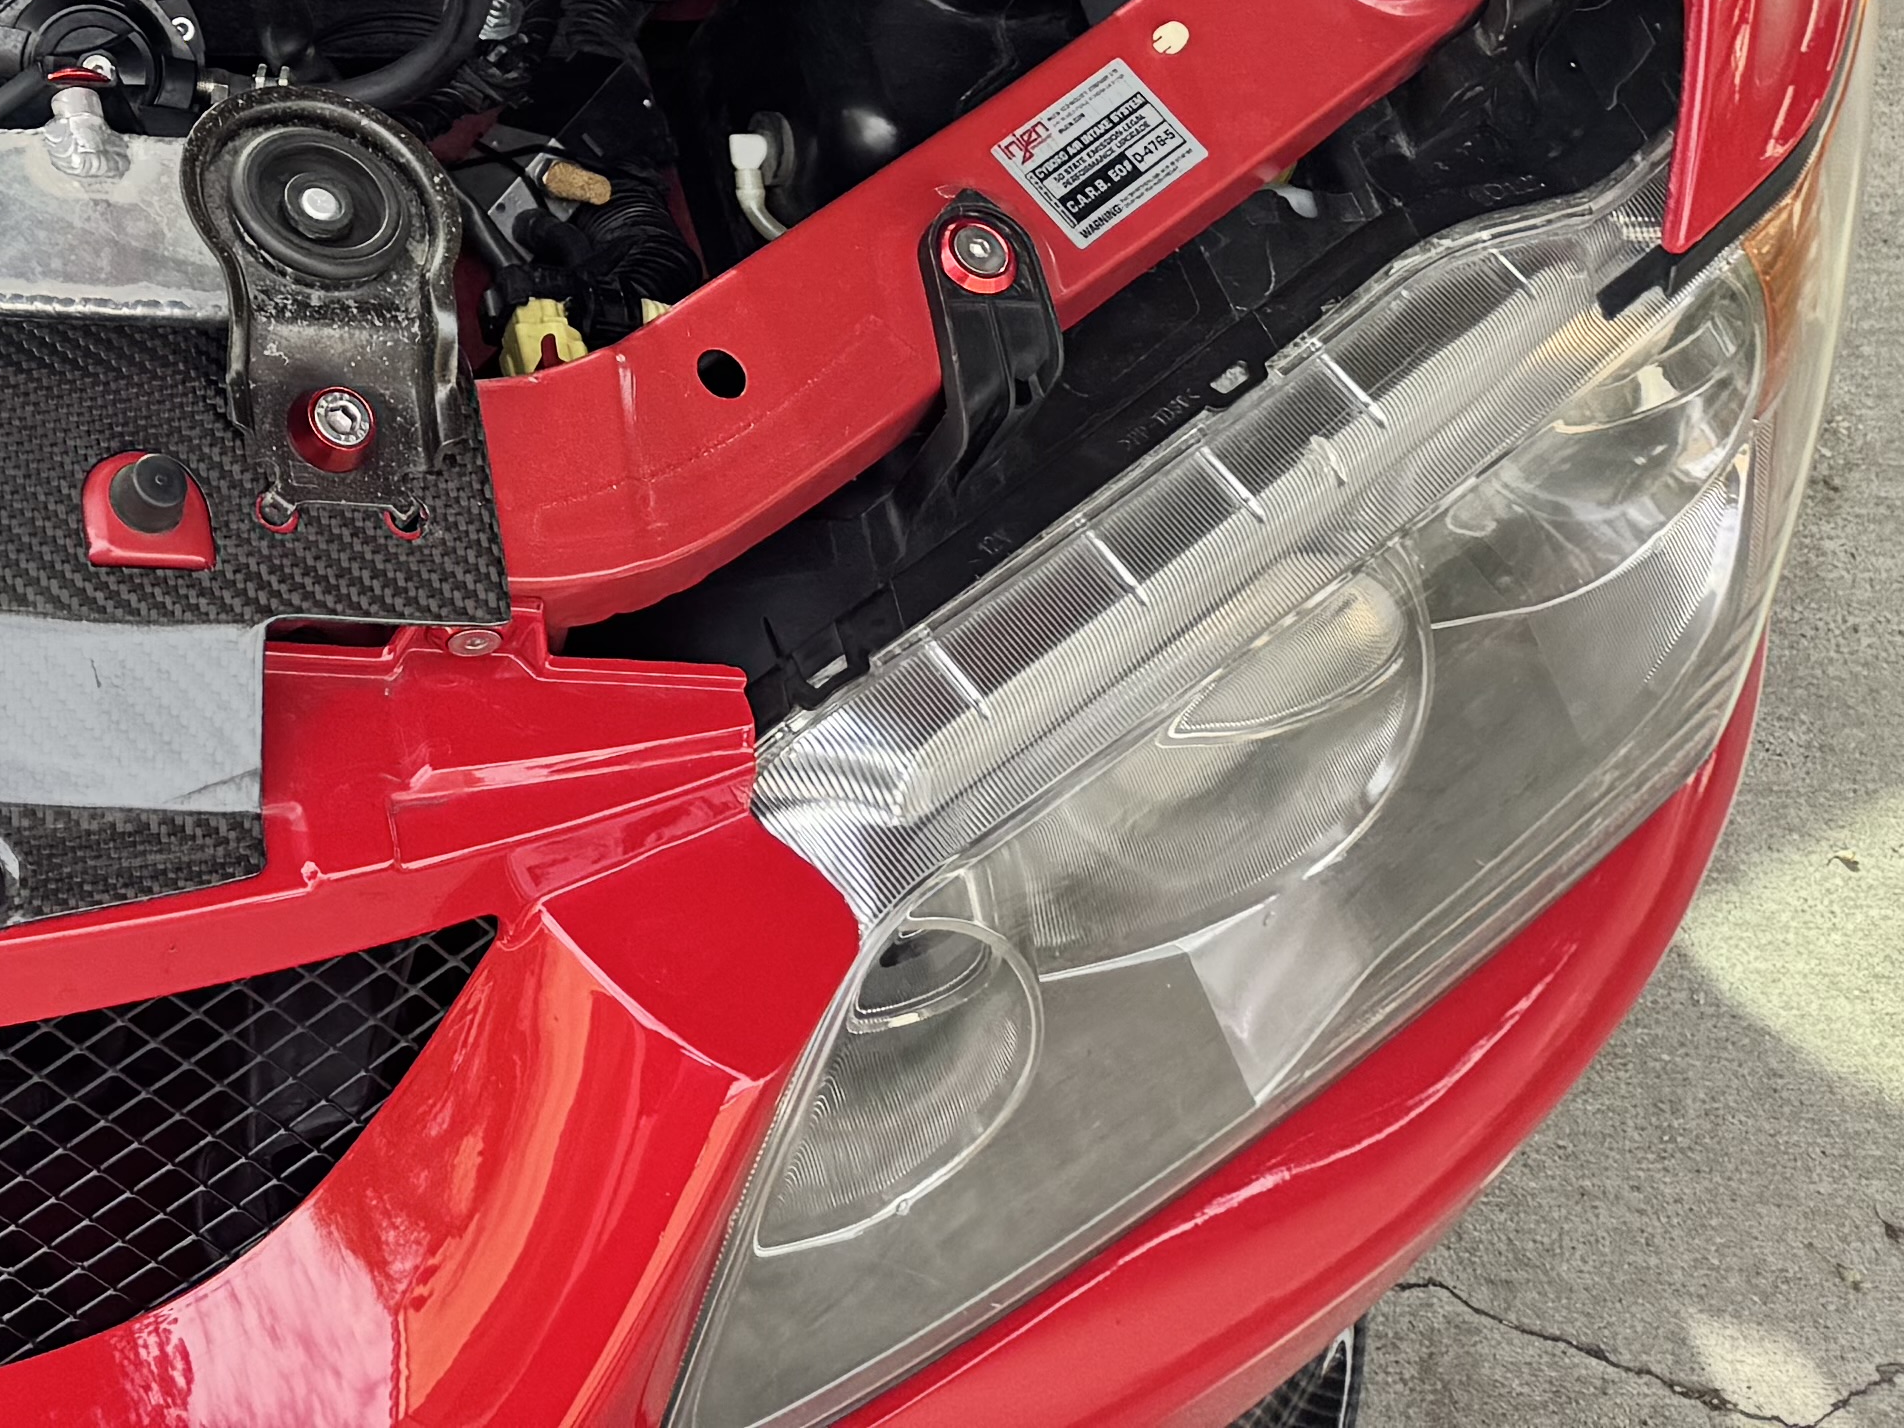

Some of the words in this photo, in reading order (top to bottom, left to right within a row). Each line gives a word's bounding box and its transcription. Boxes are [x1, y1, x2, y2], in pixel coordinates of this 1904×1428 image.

[997, 120, 1049, 165] injen
[1064, 156, 1087, 176] STATE
[1088, 128, 1125, 161] EMISSION
[1122, 114, 1146, 133] LEGAL
[1082, 119, 1112, 145] INTAKE
[1109, 93, 1146, 127] SYSTEM
[1062, 148, 1116, 189] PERFORMANCE
[1115, 122, 1151, 153] UPGRADE
[1066, 176, 1112, 214] C.A.R.B.
